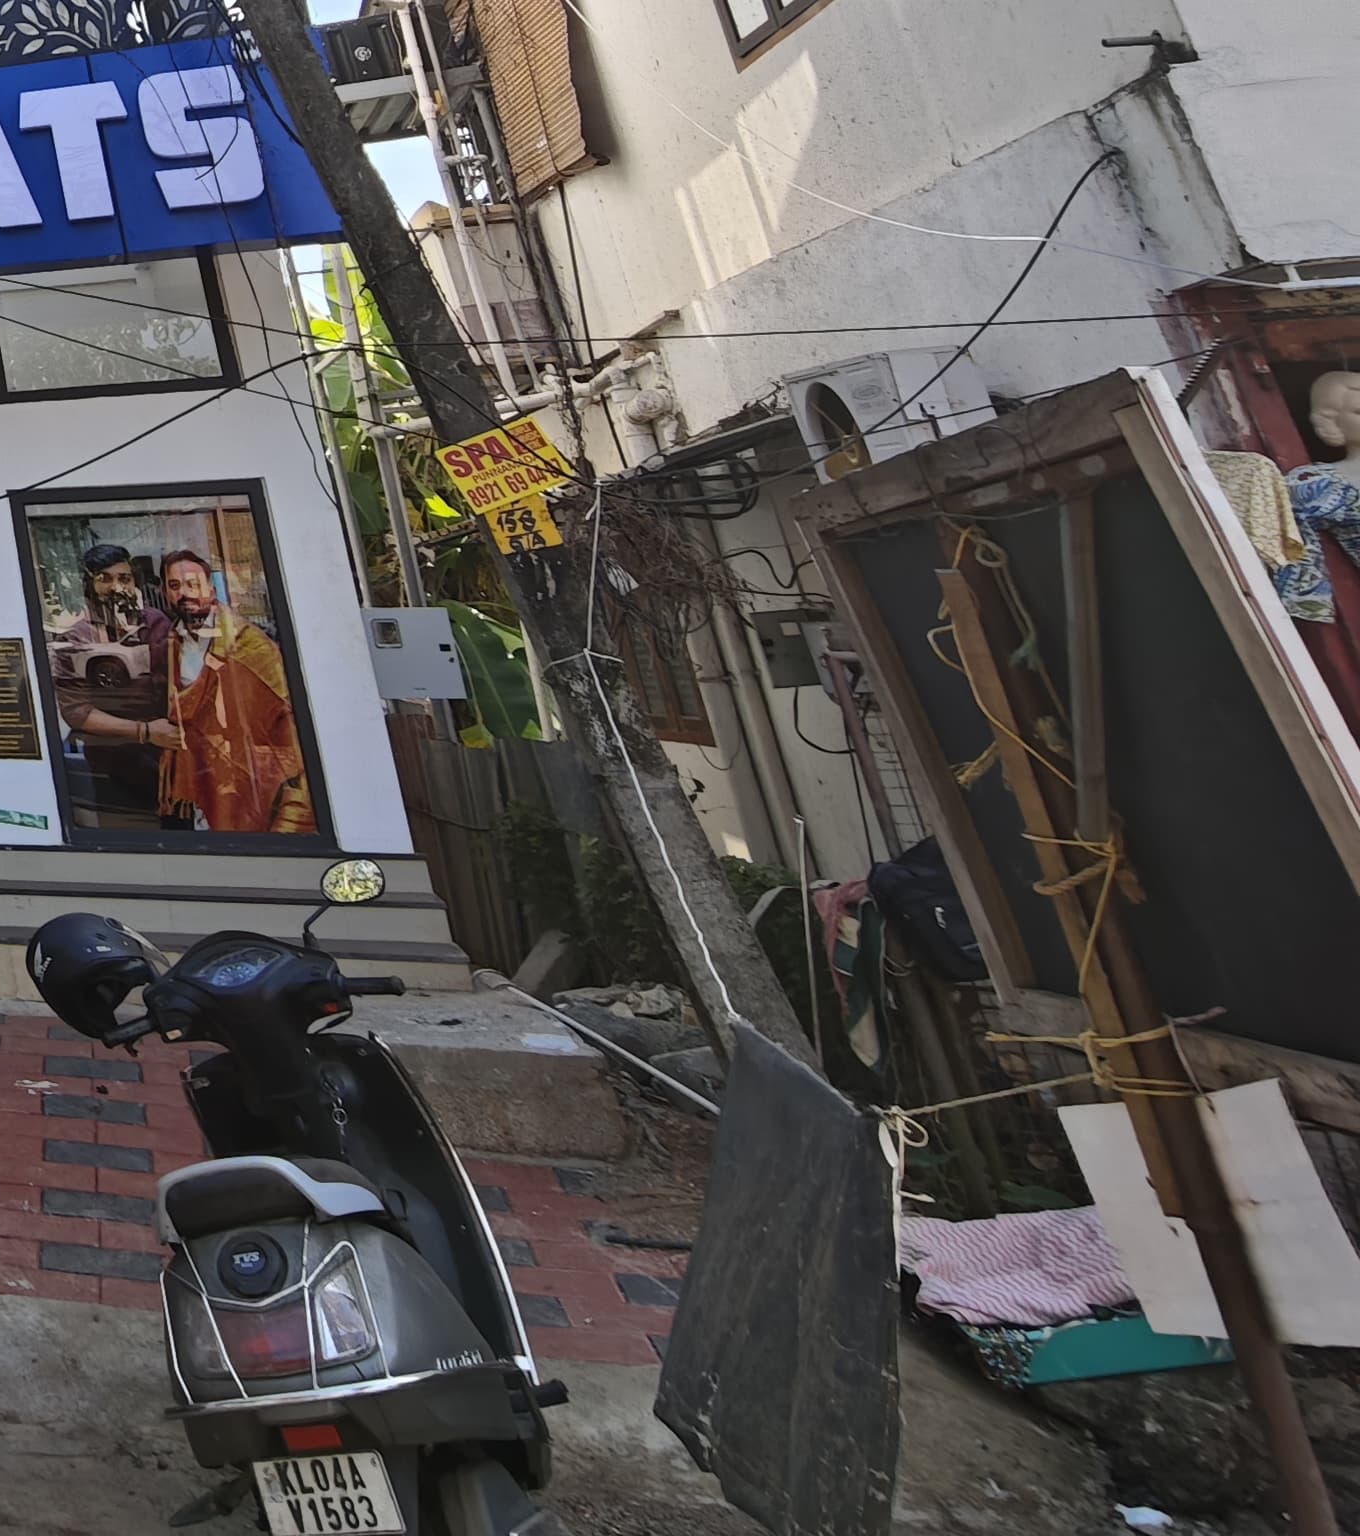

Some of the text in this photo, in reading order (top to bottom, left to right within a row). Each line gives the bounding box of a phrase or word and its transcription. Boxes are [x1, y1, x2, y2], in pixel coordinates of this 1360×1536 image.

[444, 436, 513, 478] SPA
[467, 480, 507, 508] 8921
[504, 472, 528, 494] 69
[273, 1455, 367, 1496] KL04A
[286, 1495, 378, 1533] V1583
